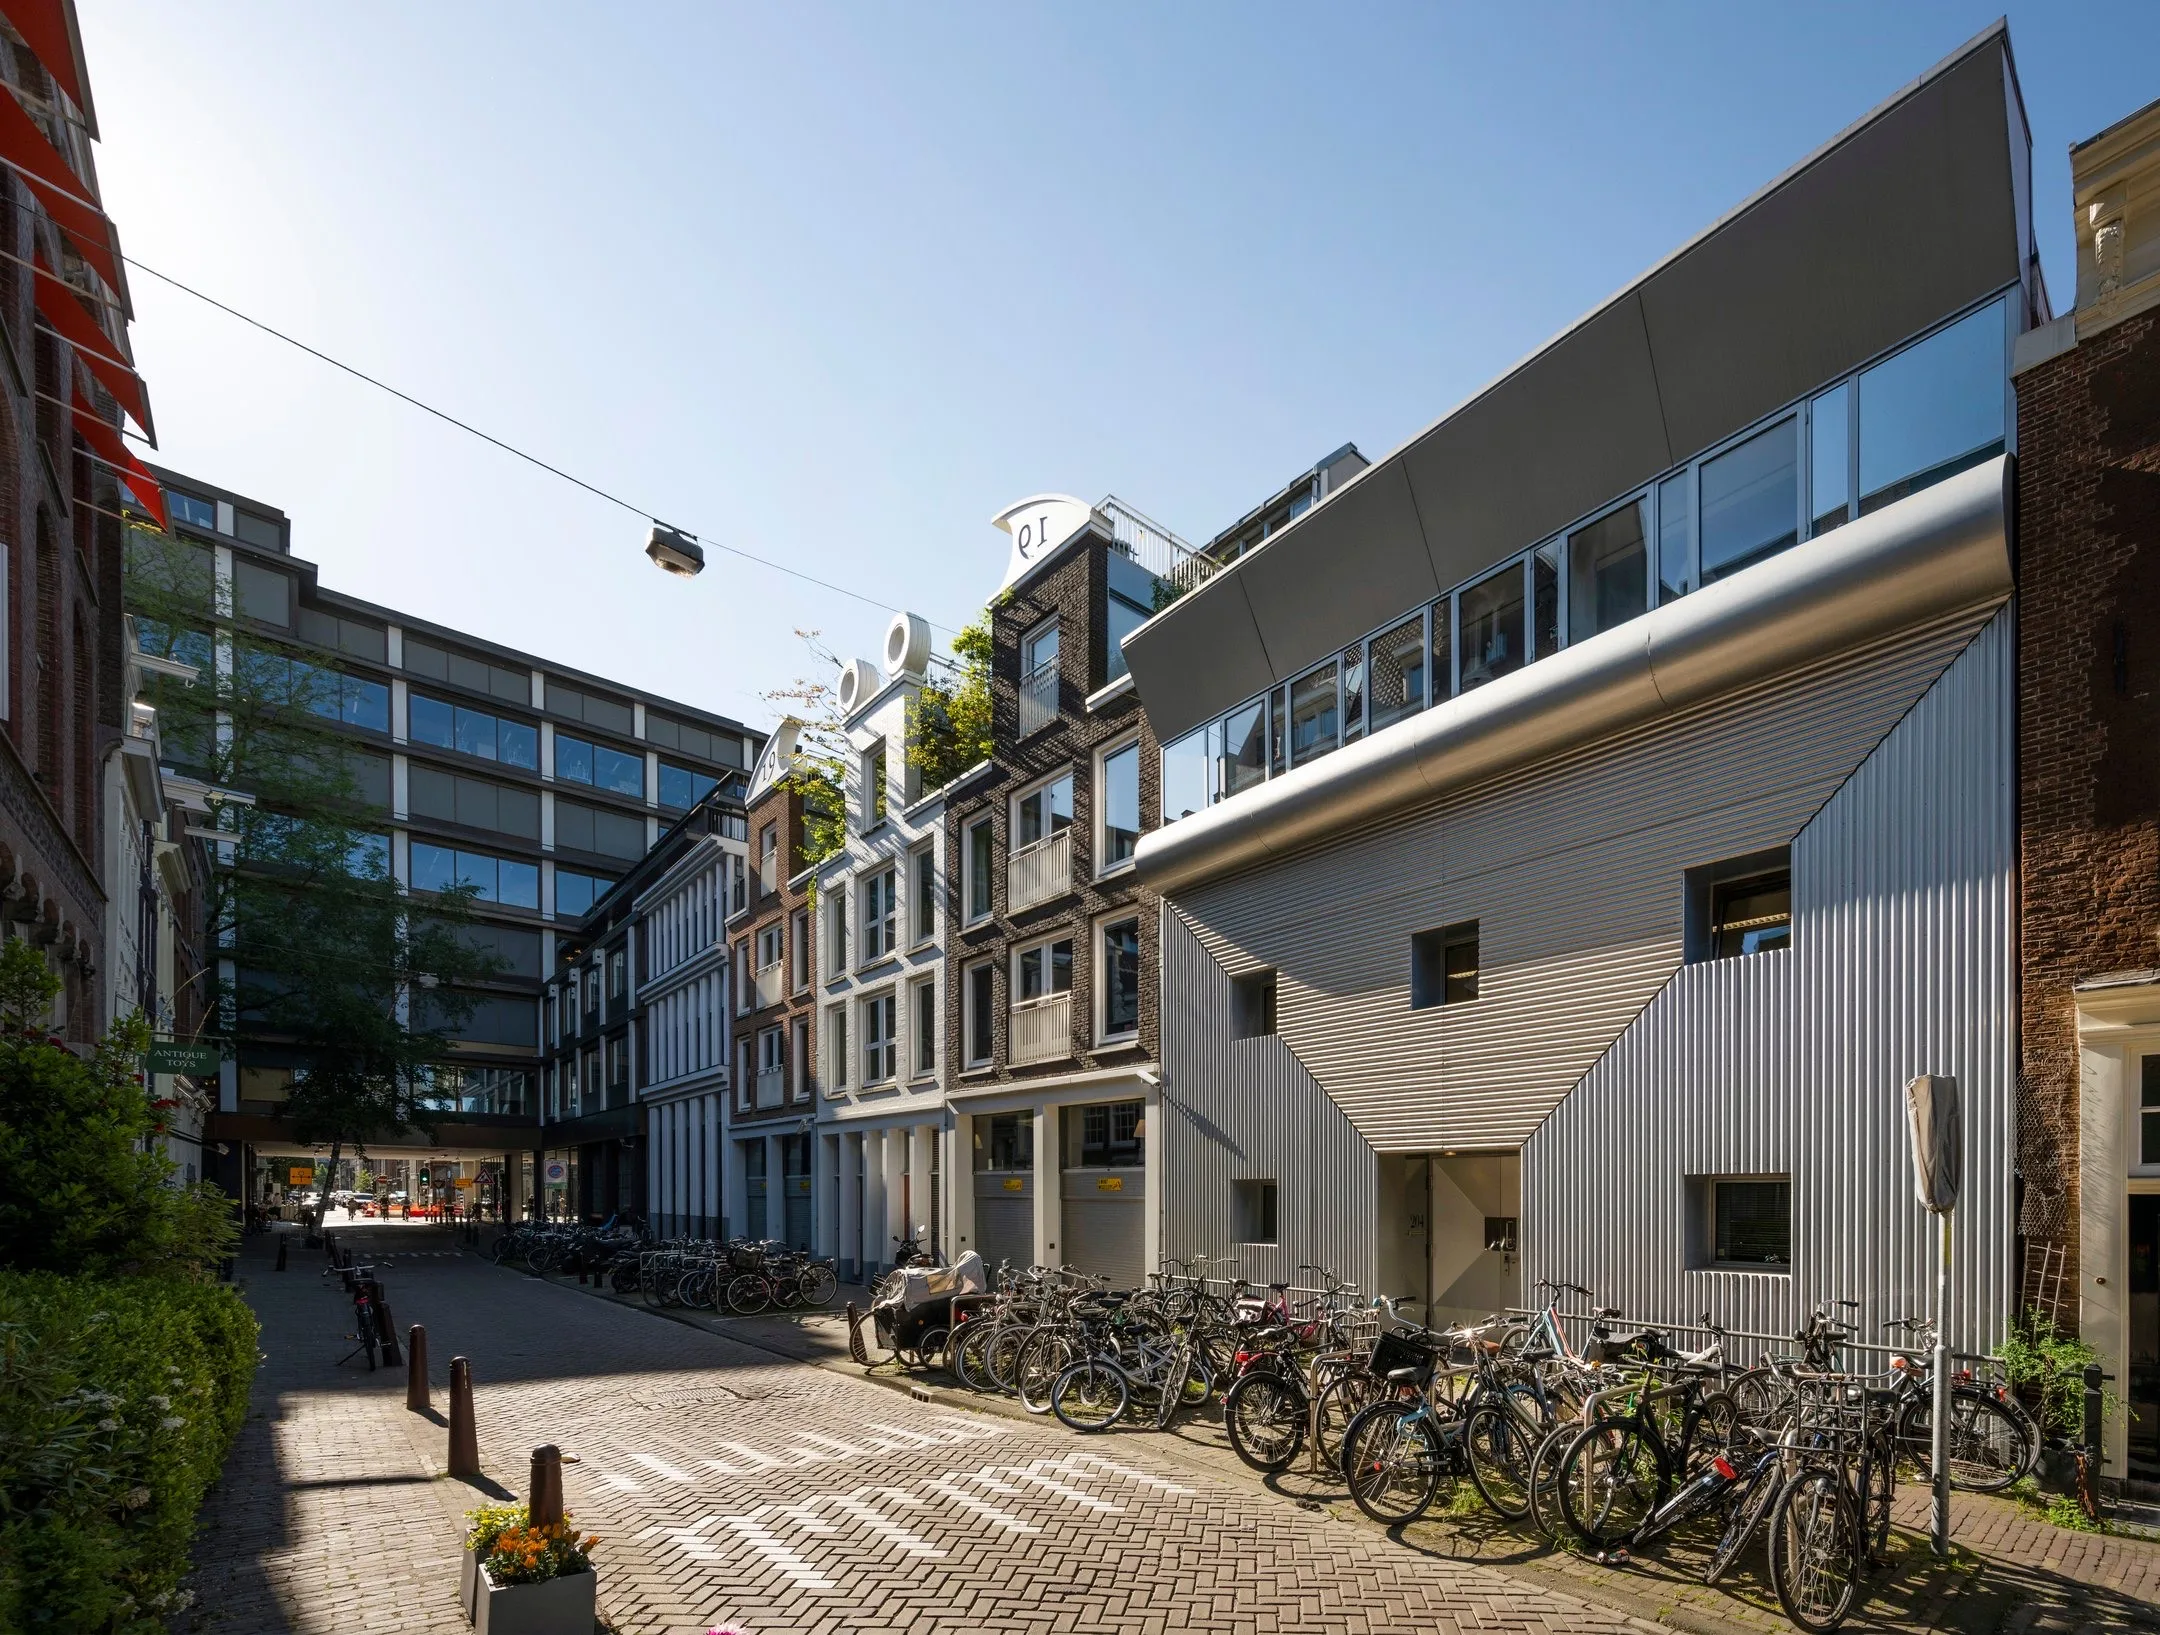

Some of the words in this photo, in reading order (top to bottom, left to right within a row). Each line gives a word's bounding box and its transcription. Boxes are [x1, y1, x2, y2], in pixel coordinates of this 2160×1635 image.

[762, 751, 776, 782] 19
[154, 1049, 207, 1060] ANTIQUE
[166, 1059, 196, 1068] TOYS
